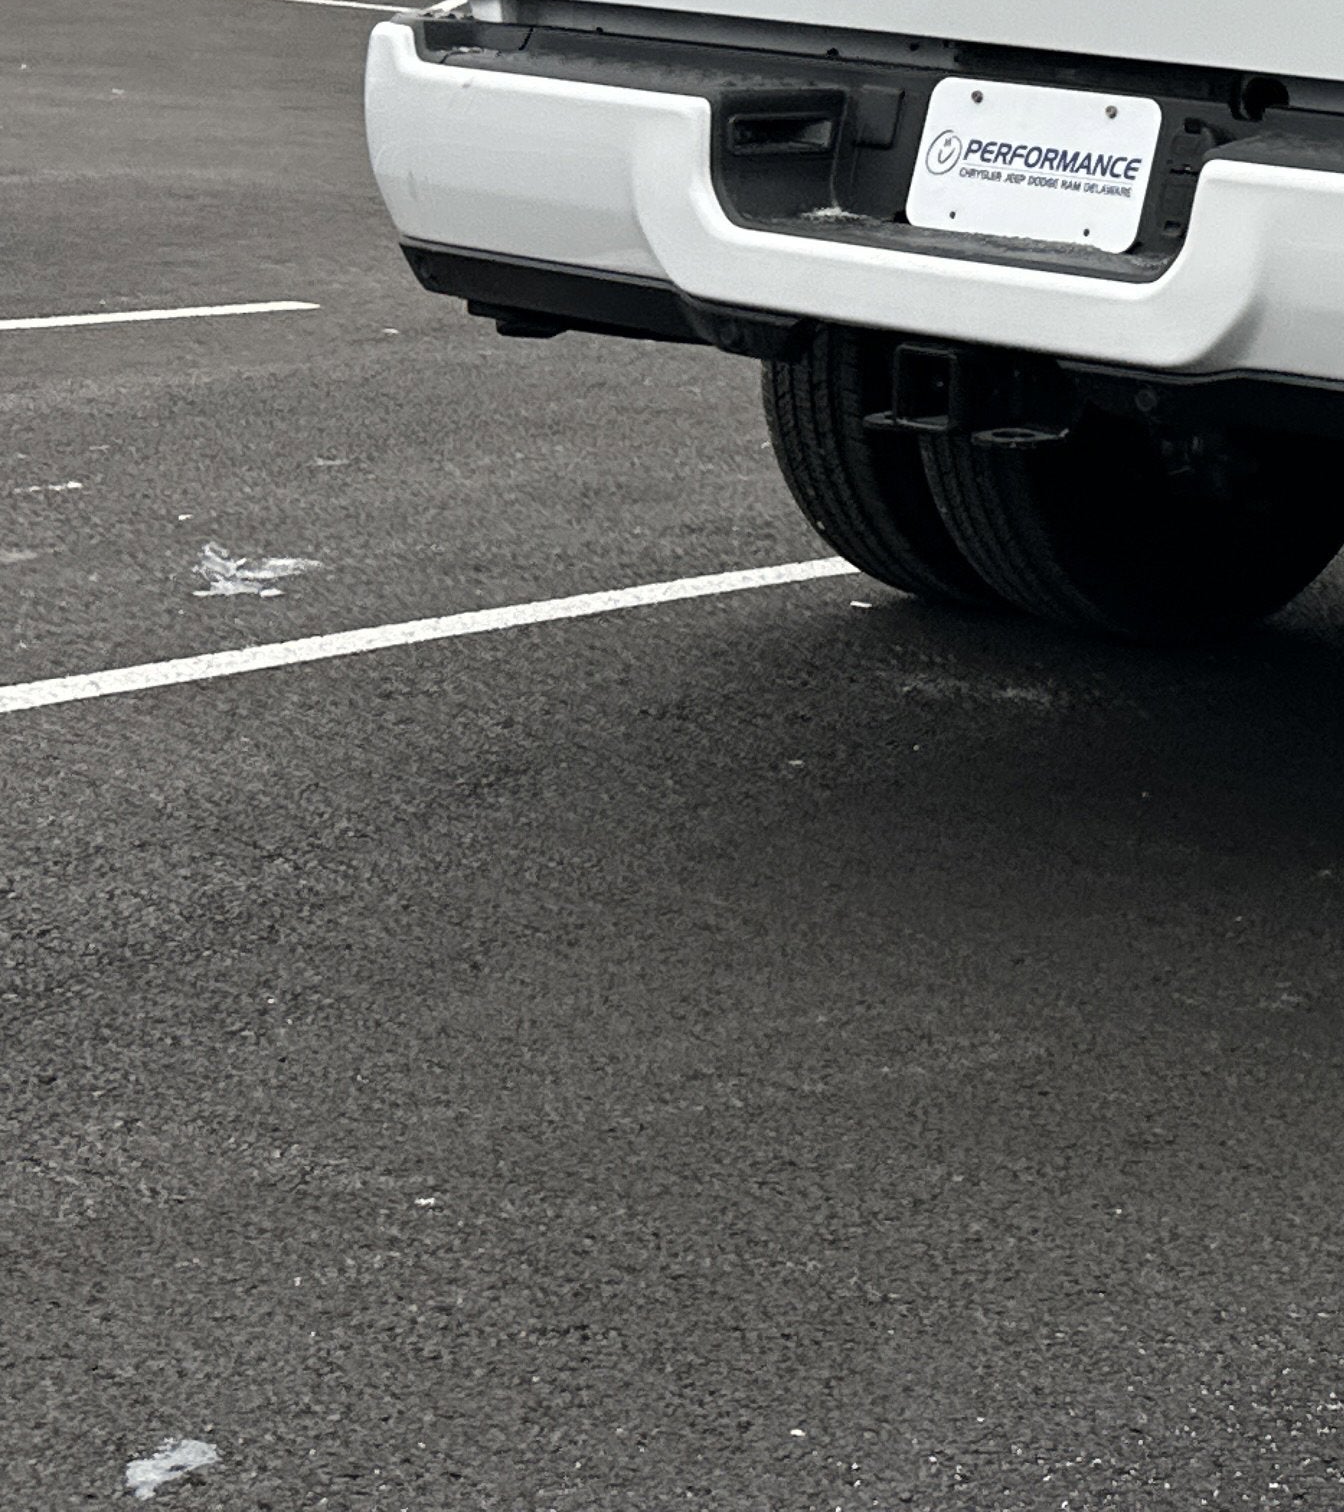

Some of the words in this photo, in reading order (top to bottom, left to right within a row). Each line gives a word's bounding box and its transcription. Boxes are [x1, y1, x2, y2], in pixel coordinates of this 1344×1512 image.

[963, 138, 1142, 180] PERFORMANCE
[959, 166, 1002, 183] CHRYSLER
[1003, 171, 1027, 185] JEEP
[1027, 175, 1059, 190] DODGE
[1060, 178, 1082, 193] RAM
